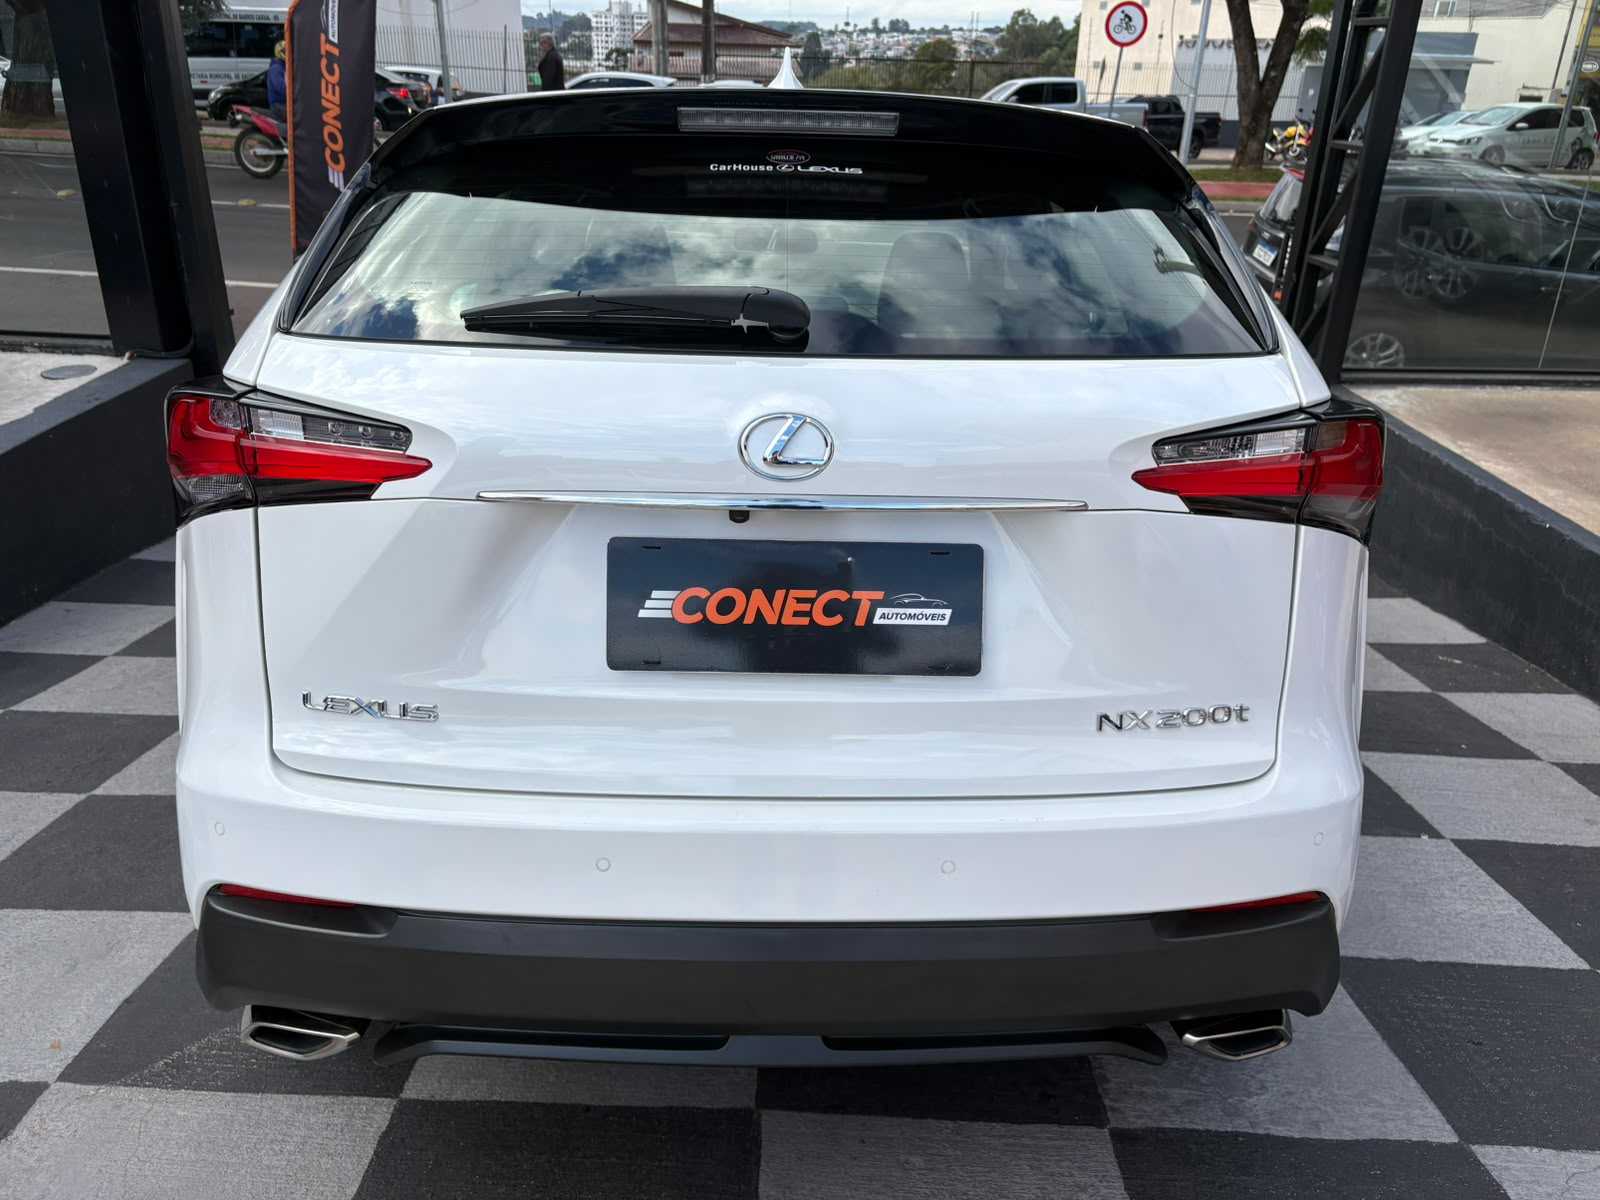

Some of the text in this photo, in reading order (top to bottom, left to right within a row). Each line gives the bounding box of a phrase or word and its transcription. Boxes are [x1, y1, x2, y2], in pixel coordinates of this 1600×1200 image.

[320, 33, 346, 174] CONECT
[710, 163, 863, 174] CarHouse LEXUS
[671, 587, 885, 626] CONECT
[878, 611, 948, 624] AUTOMÓVEIS
[302, 690, 440, 722] LEXUS
